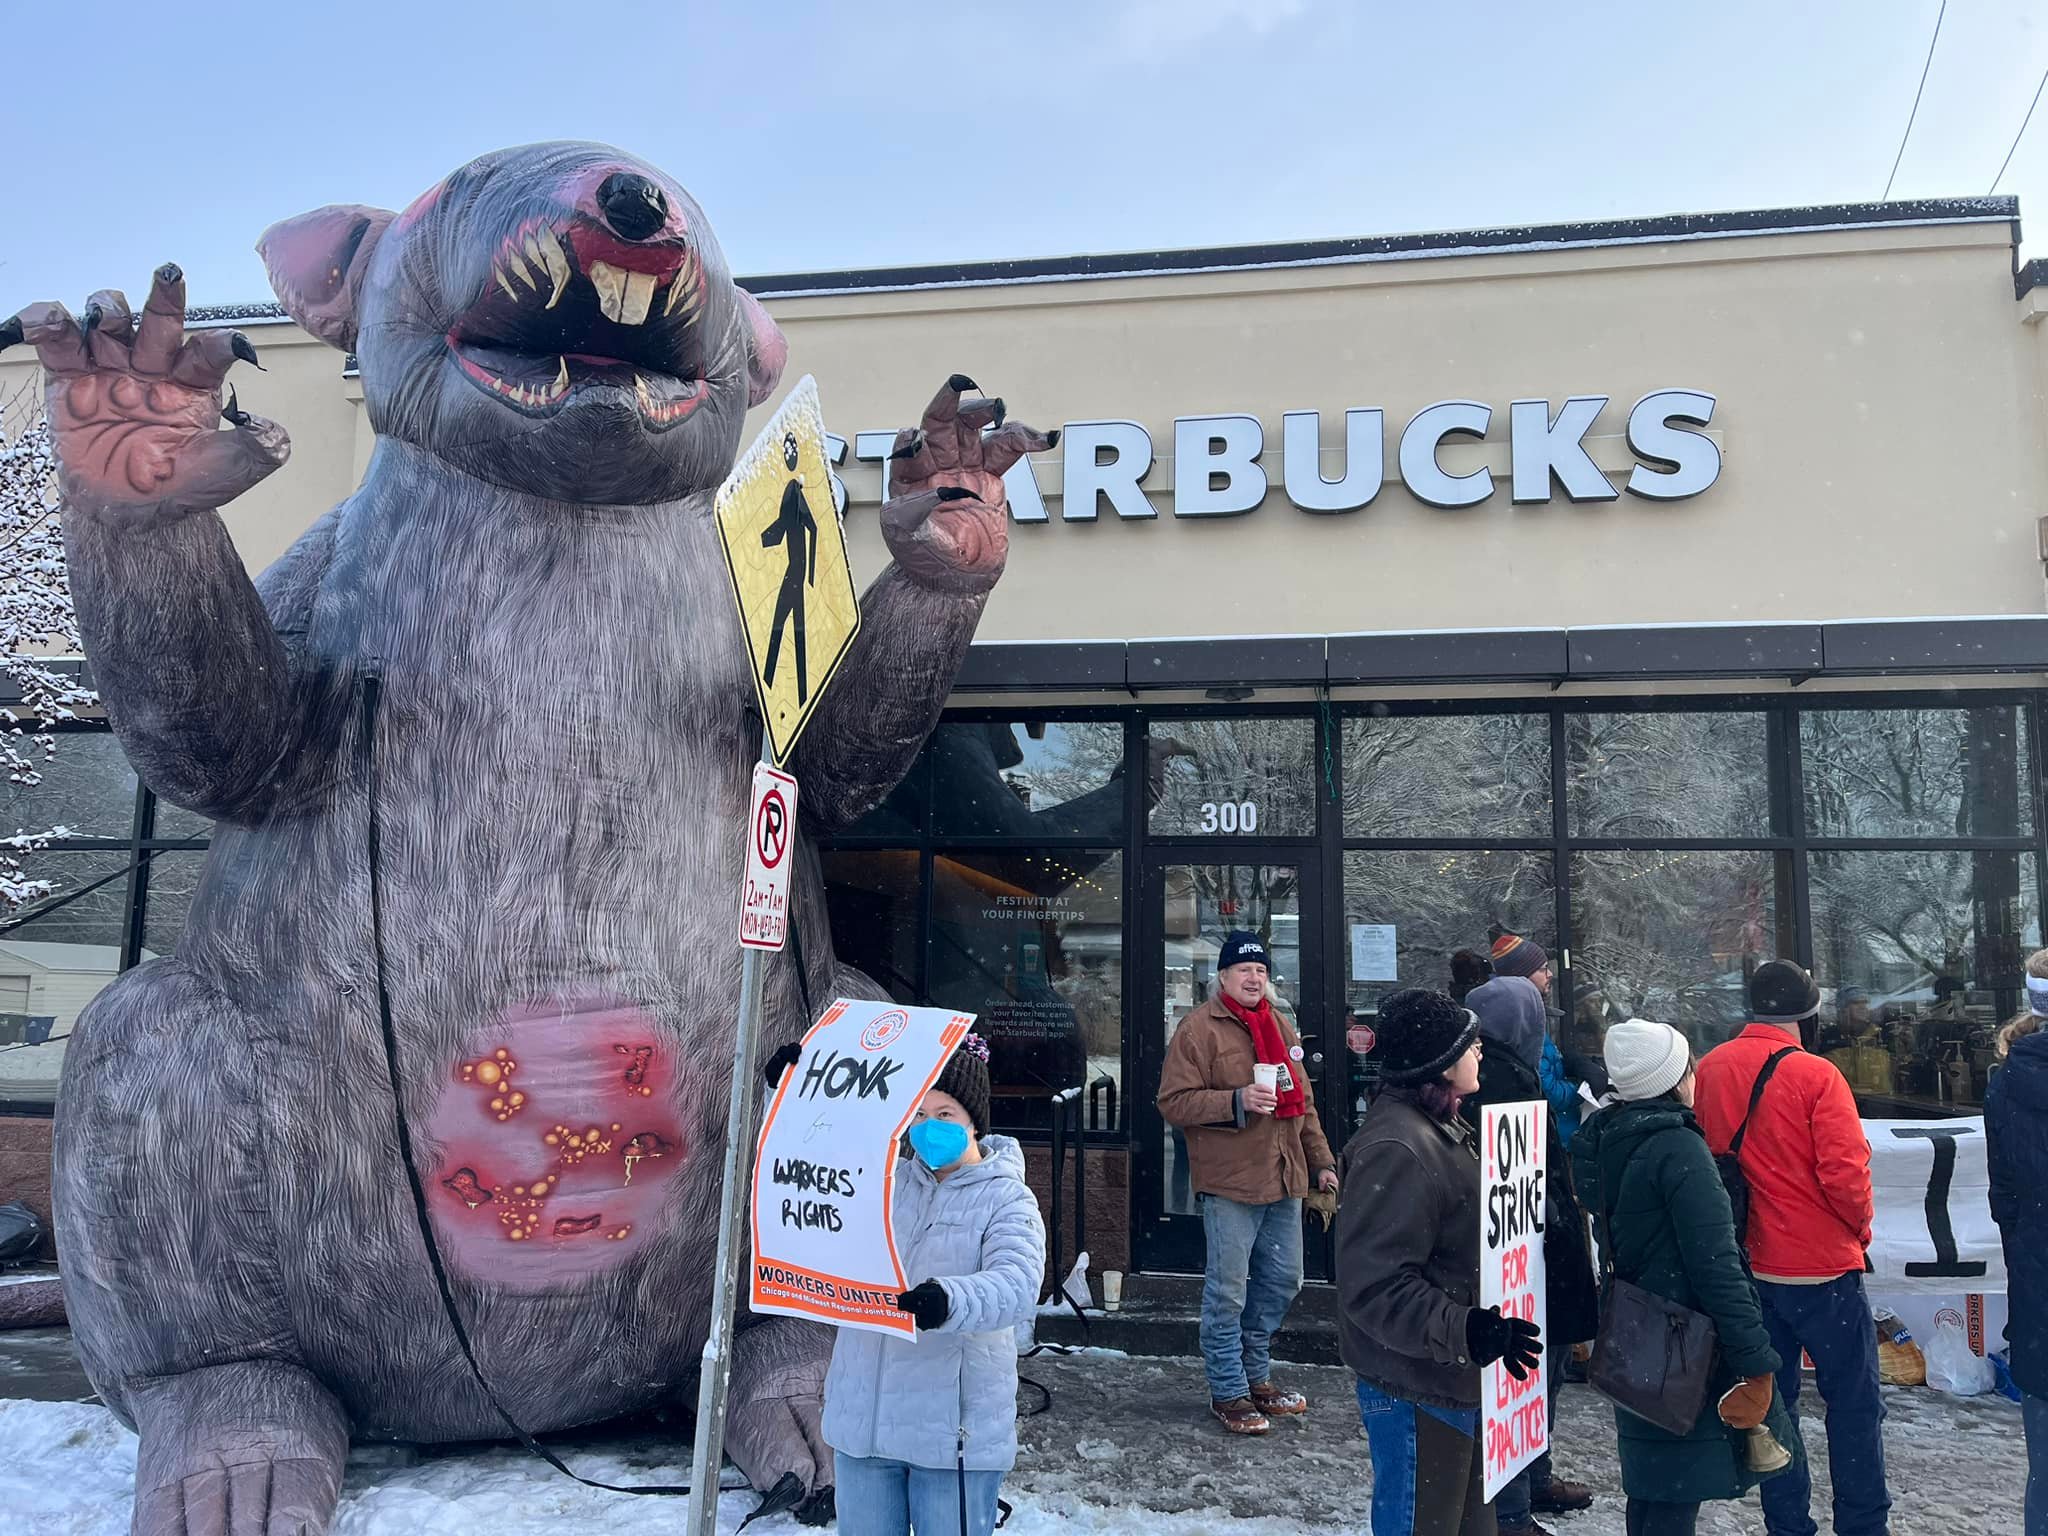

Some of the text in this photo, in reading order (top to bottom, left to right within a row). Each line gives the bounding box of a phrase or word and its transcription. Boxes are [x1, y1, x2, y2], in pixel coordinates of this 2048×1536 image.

[826, 388, 1722, 524] RBUCKS
[1200, 802, 1257, 833] 300
[981, 910, 1085, 921] YOUR FINGERTIPS
[996, 896, 1070, 907] FESTIVITY AT
[798, 1048, 904, 1102] HONK
[781, 1199, 844, 1233] RIGHTS
[1487, 1169, 1545, 1250] STRIKE
[758, 1264, 836, 1299] WORKERS
[1502, 1242, 1529, 1296] FOR
[760, 1286, 909, 1320] Chicago and Midwest Regional Joint Board
[1970, 1294, 1980, 1339] ORKERS
